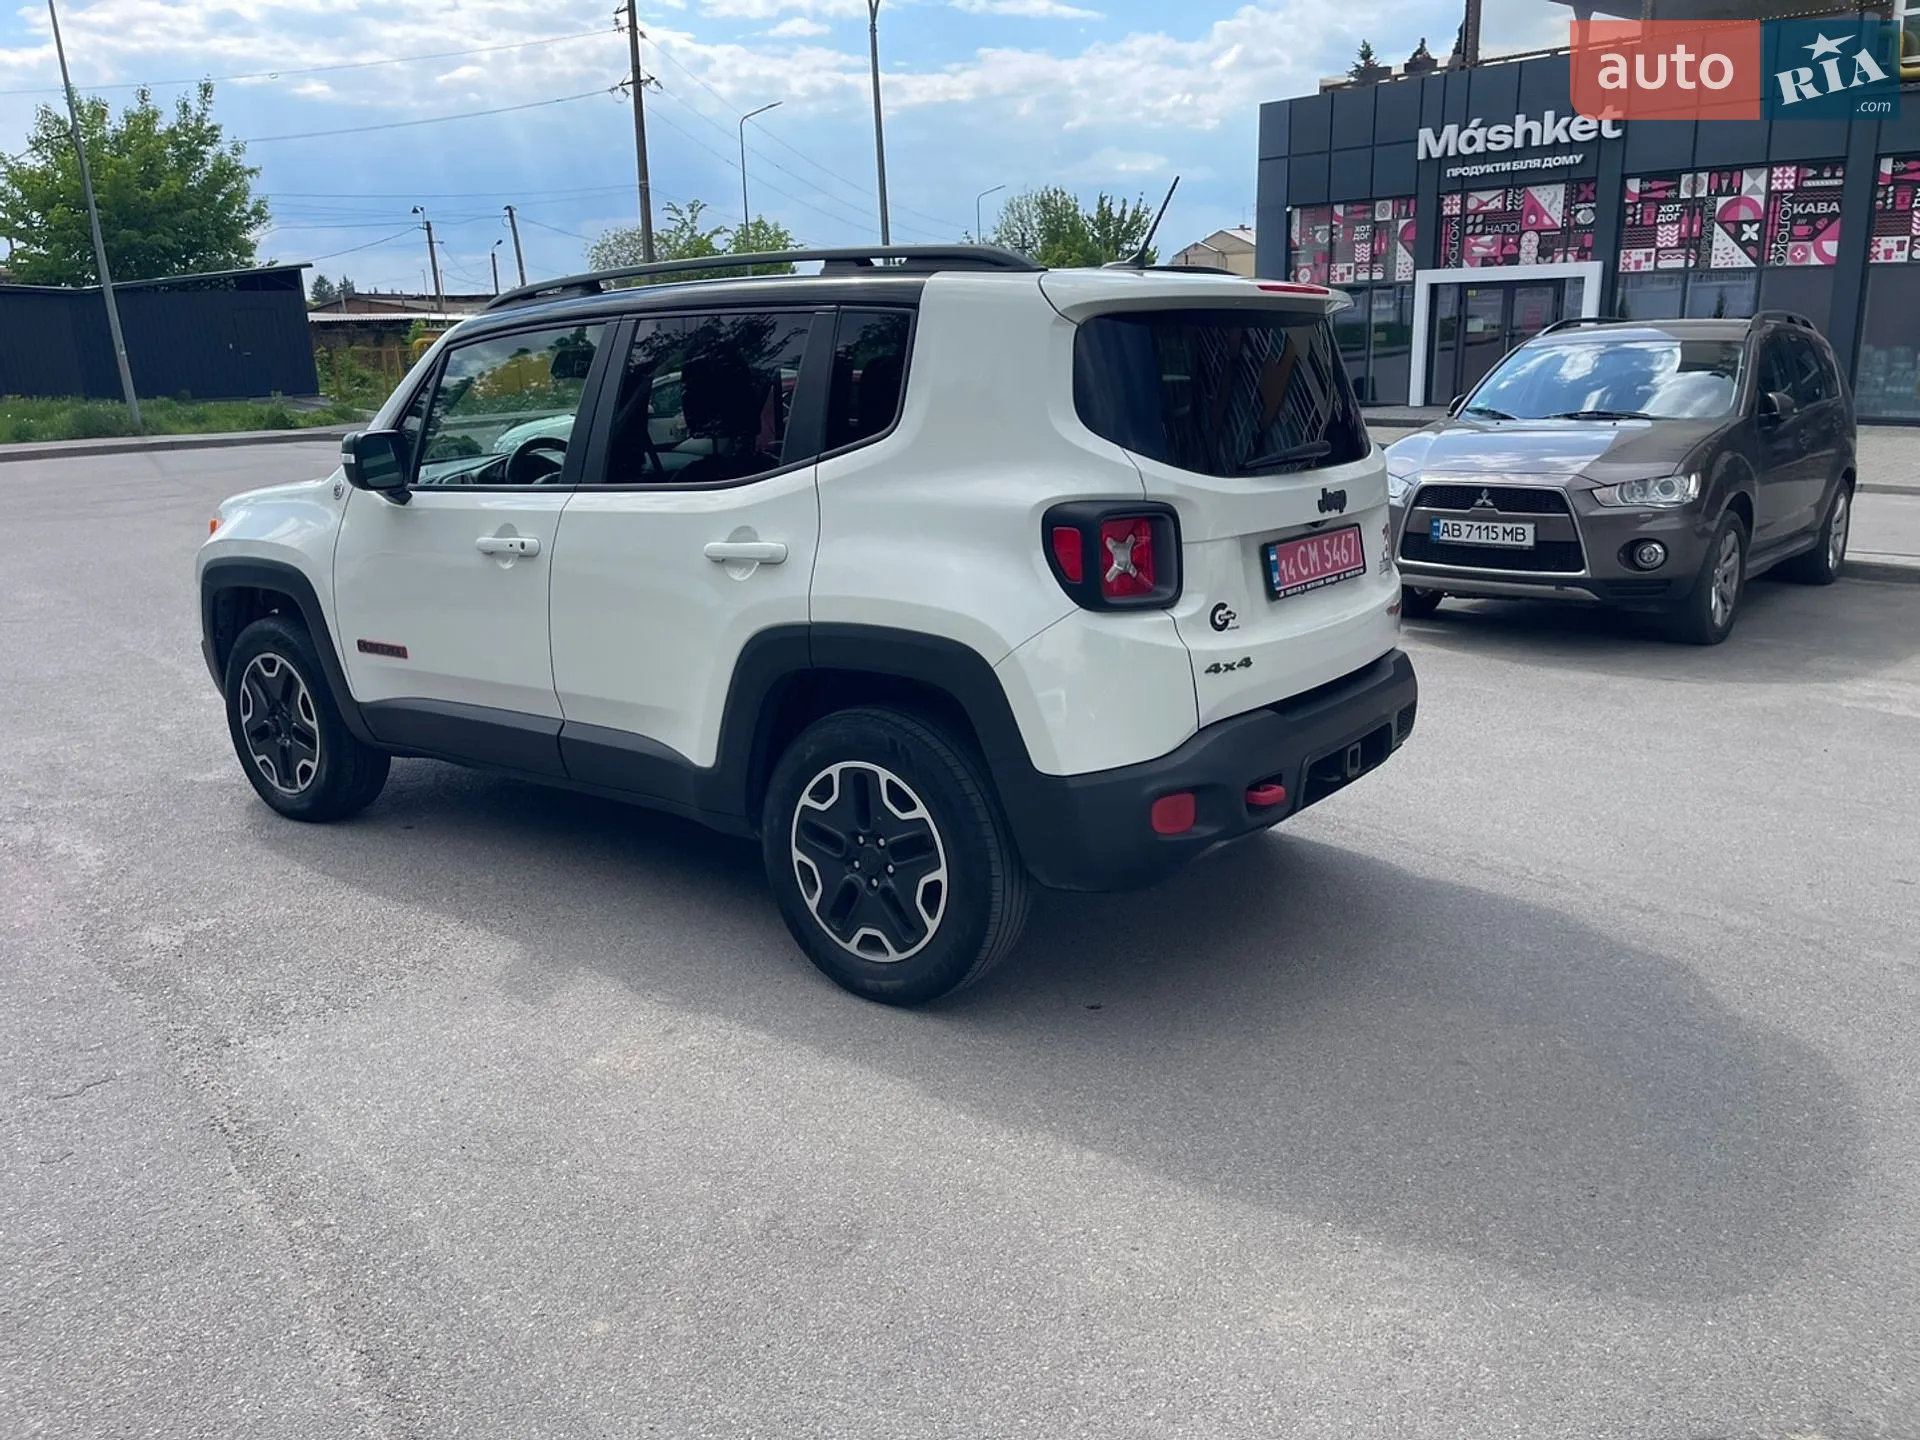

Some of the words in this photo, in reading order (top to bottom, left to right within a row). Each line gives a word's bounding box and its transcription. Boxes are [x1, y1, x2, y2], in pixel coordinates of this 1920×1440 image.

[1416, 104, 1624, 160] Máshket
[1446, 162, 1511, 178] ПРОДУКТИ
[1512, 159, 1541, 170] БІЛЯ
[1542, 154, 1584, 169] ДОМУ
[1656, 213, 1680, 223] ДОГ
[1793, 201, 1840, 214] КАВА
[1352, 232, 1370, 241] ДОГ
[1485, 222, 1520, 234] НАПОЇ
[1774, 192, 1794, 267] МОЛОКО
[1317, 488, 1347, 513] Jeep
[1441, 522, 1462, 538] AB
[1465, 524, 1499, 541] 7115
[1502, 526, 1527, 542] MB
[1280, 557, 1297, 584] 14
[1297, 542, 1320, 576] CM
[1323, 533, 1356, 570] 5467
